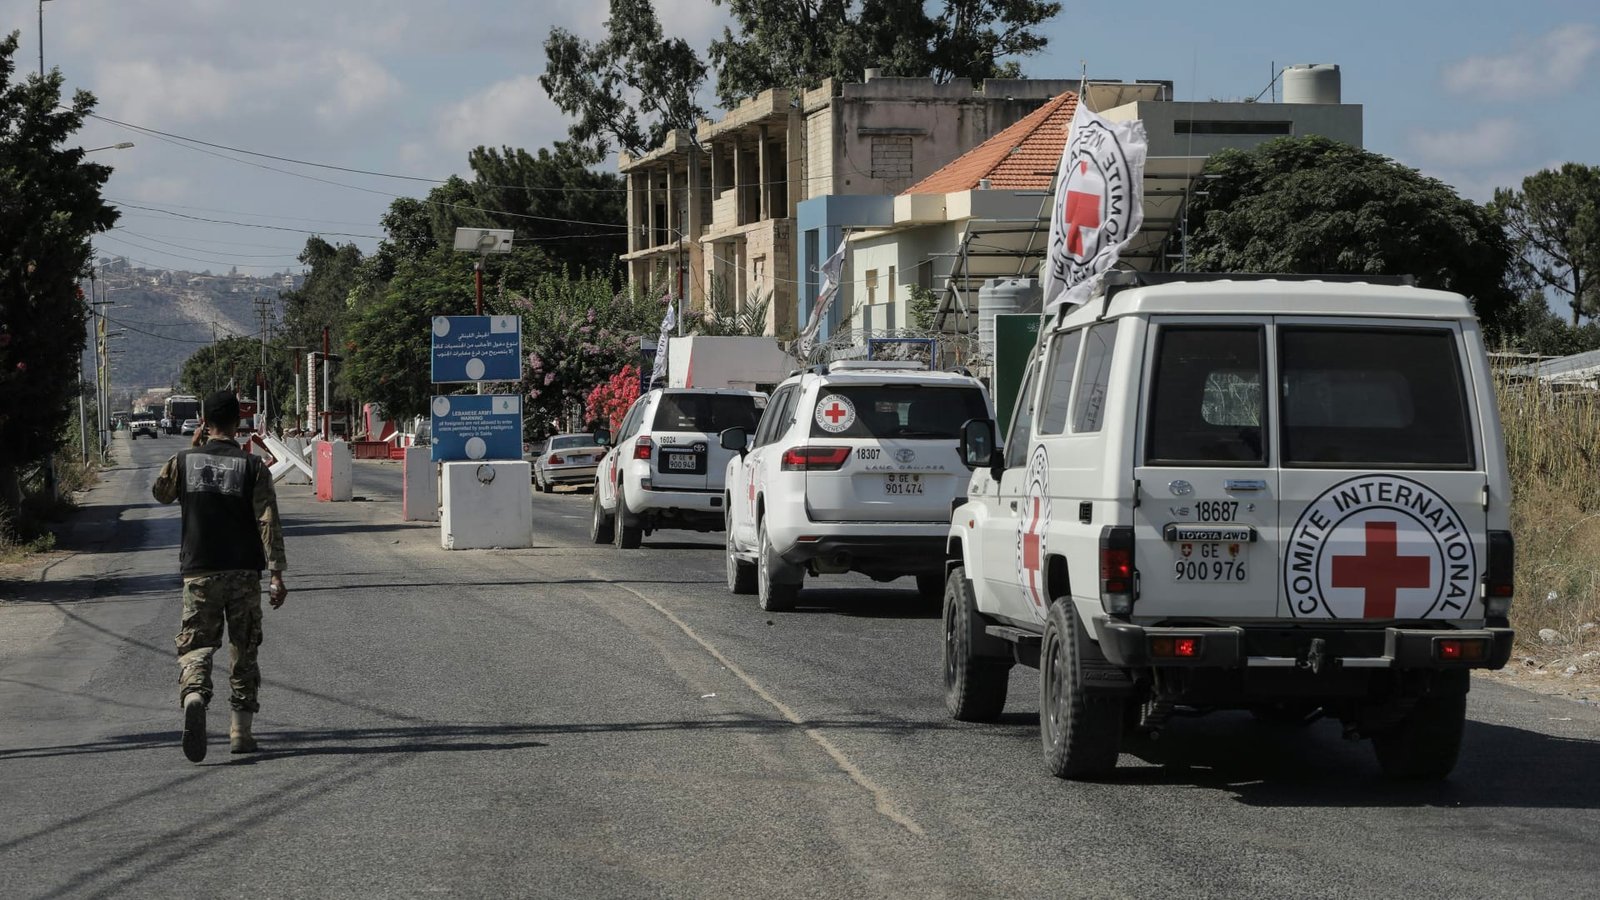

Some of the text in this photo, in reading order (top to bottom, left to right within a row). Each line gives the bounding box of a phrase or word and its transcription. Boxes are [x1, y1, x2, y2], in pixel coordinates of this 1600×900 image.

[856, 448, 880, 460] 18307
[899, 474, 909, 482] GE
[886, 483, 923, 494] 901 474
[1194, 501, 1239, 521] 18687
[1181, 532, 1248, 540] TOYOTA 4WD
[1201, 544, 1220, 558] GE
[1292, 482, 1470, 614] COMITE INTERNATIONAL
[1175, 561, 1246, 581] 900 976
